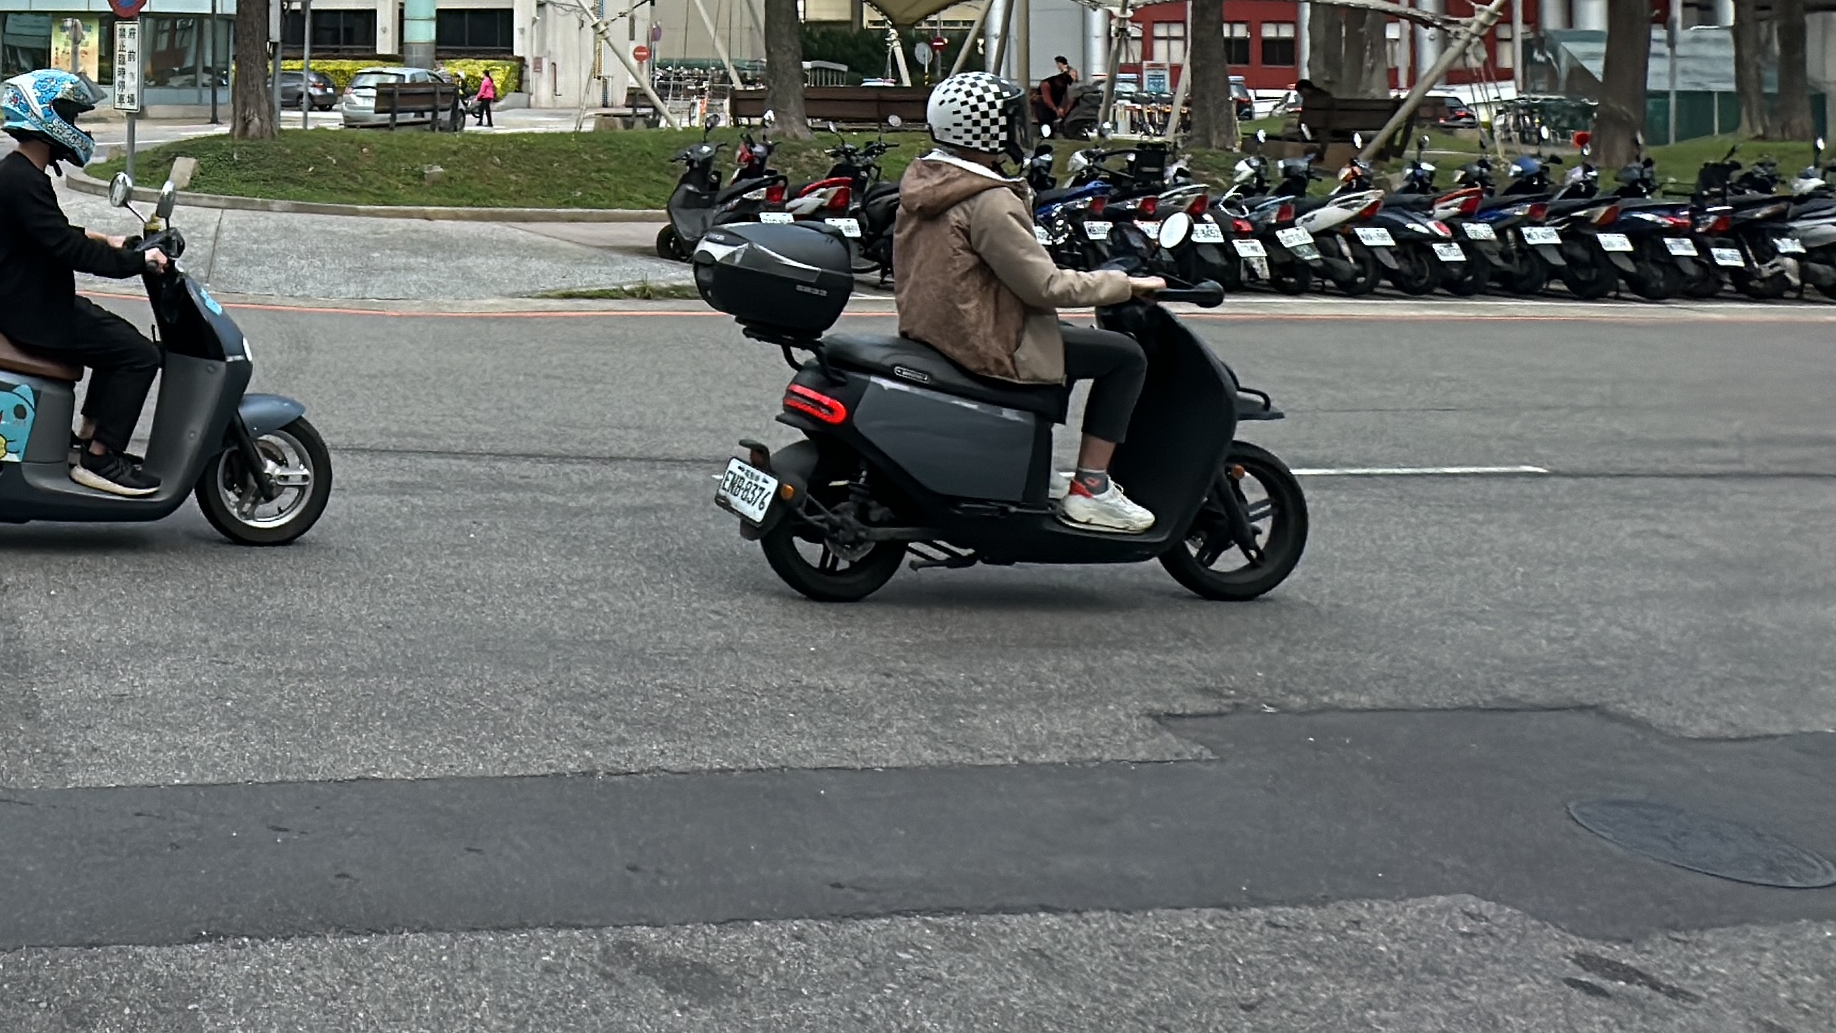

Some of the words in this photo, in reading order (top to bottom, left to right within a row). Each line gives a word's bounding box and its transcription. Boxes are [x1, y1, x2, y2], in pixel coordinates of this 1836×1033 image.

[117, 28, 126, 106] 禁止臨時停車
